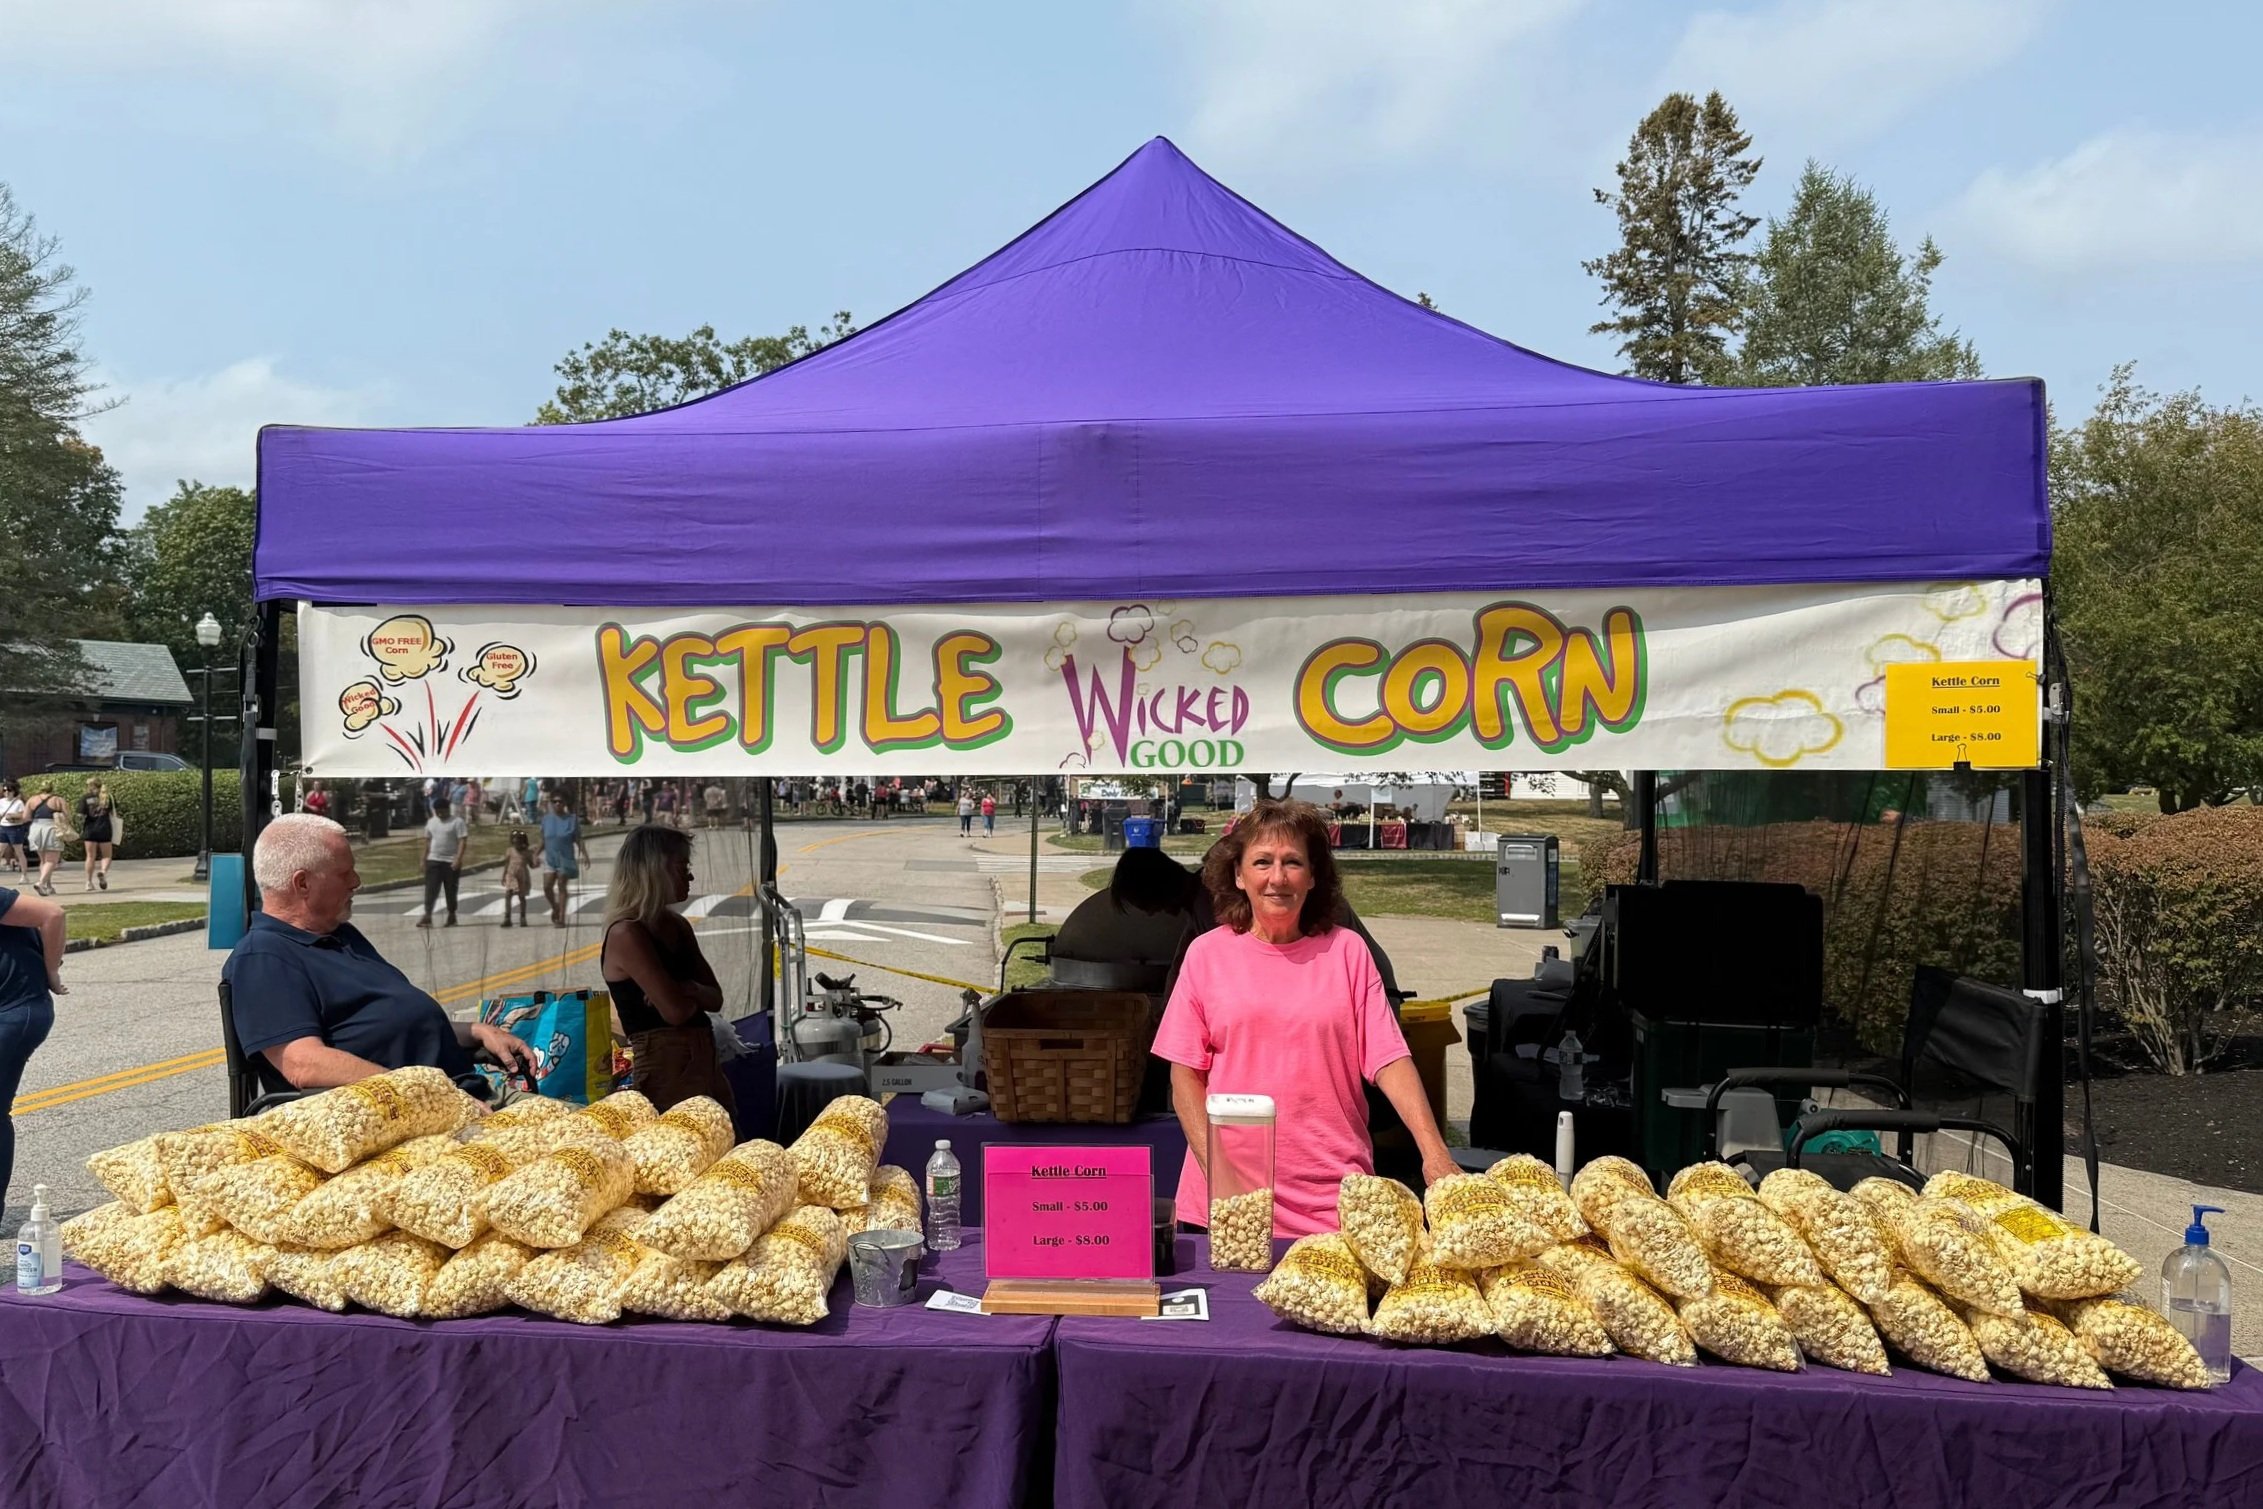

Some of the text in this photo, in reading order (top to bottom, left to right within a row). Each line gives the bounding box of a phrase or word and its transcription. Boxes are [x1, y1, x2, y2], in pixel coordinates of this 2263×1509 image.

[371, 637, 422, 646] GMO FREE
[385, 646, 409, 655] Corn
[486, 652, 518, 661] Gluten
[492, 661, 514, 670] Free
[1293, 601, 1648, 756] CORN
[1931, 676, 2001, 687] Kettle Corn
[595, 621, 1013, 764] KETTLE
[1060, 645, 1250, 769] WICKED
[1931, 706, 1960, 714] Small
[1969, 705, 2001, 713] $5.00
[1931, 734, 1961, 743] Large
[1970, 733, 2002, 741] $8.00
[1130, 739, 1245, 768] GOOD
[1031, 1165, 1107, 1177] Kettle Corn
[1032, 1201, 1063, 1212] Small
[1074, 1201, 1108, 1212] $5.00
[1033, 1235, 1065, 1247] Large
[1075, 1235, 1110, 1246] $8.00
